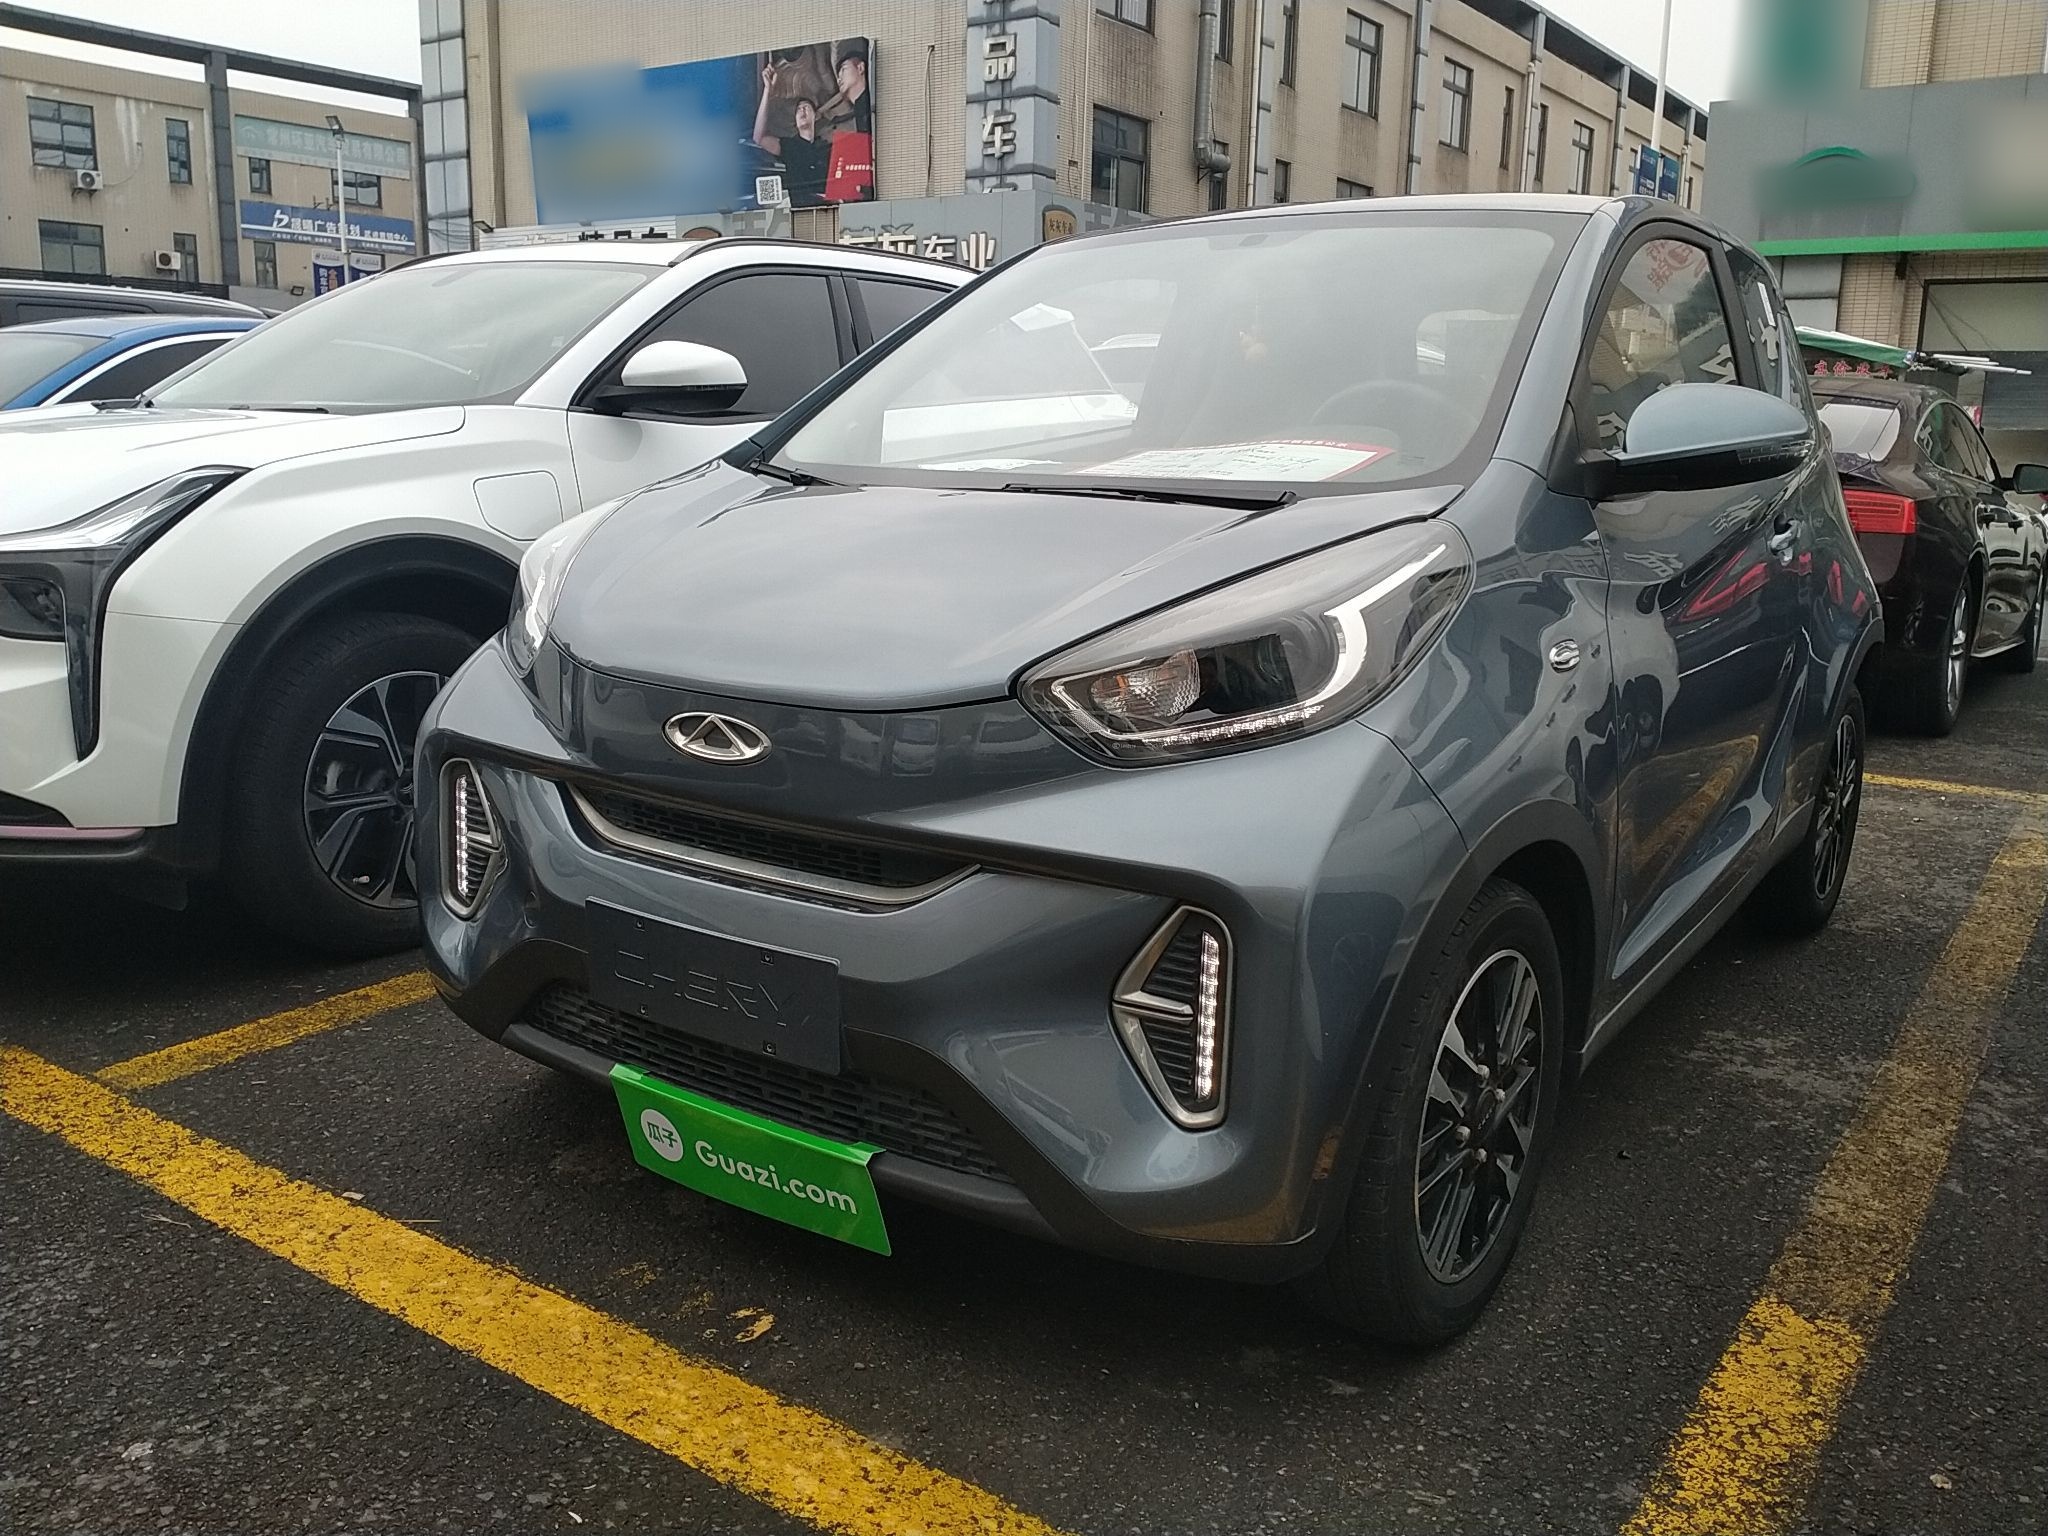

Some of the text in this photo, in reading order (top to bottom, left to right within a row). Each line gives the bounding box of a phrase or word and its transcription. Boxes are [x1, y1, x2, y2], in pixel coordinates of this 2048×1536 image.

[982, 0, 1017, 193] 品车
[614, 950, 812, 1027] CHERY
[646, 1120, 678, 1149] 瓜子
[695, 1140, 858, 1215] Guazi.com
